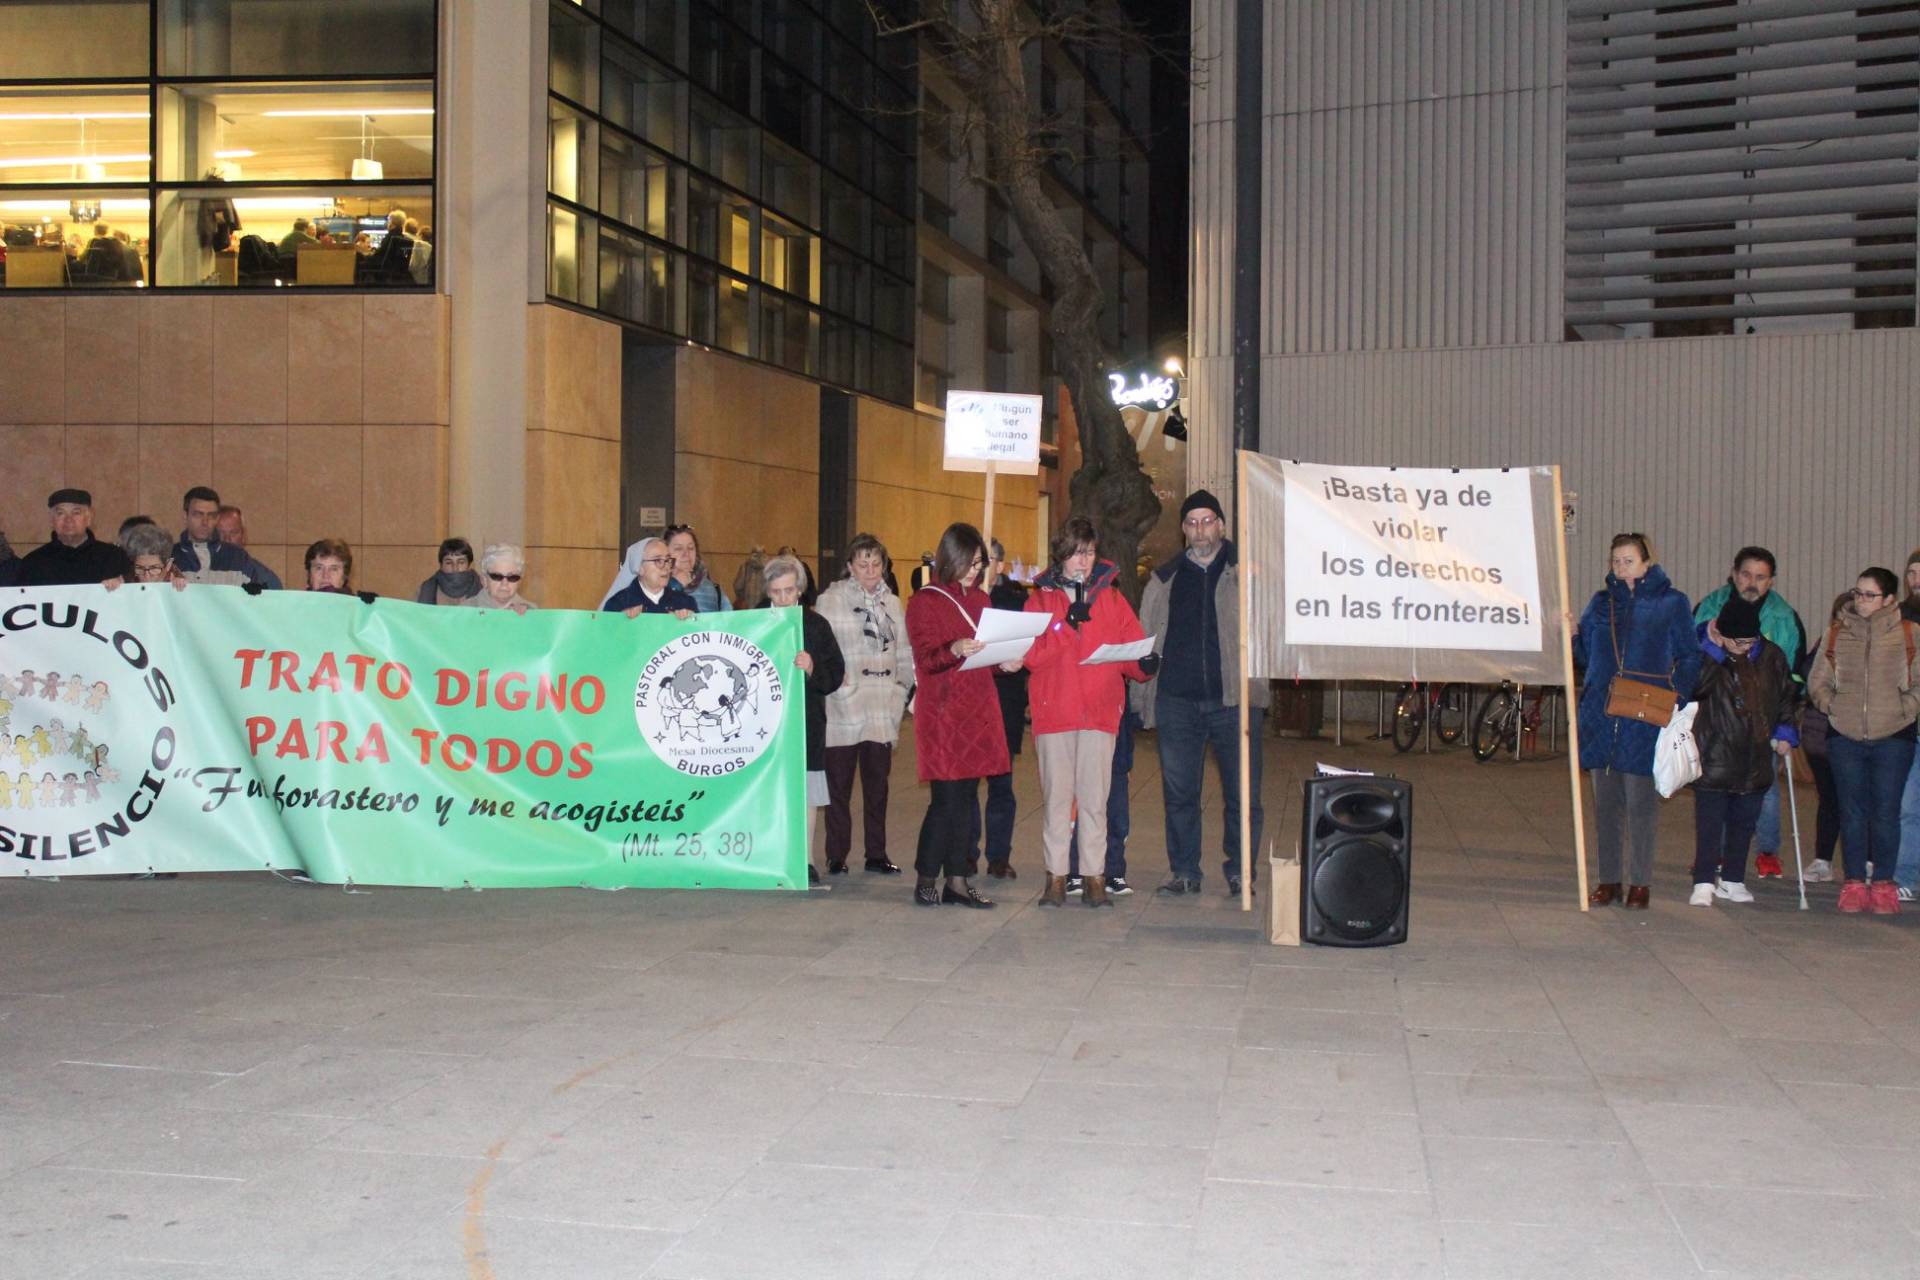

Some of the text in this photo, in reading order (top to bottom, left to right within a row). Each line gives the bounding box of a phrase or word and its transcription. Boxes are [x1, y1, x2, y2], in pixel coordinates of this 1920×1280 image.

[1323, 477, 1492, 510] ¡Basta ya de
[1373, 518, 1447, 543] violar
[1321, 552, 1502, 584] los derechos
[1296, 595, 1529, 625] en las fronteras!
[234, 649, 606, 715] TRATO DIGNO
[636, 633, 782, 708] PASTORAL CON INMIGRANTES
[245, 716, 593, 779] PARA TODOS
[669, 746, 754, 756] Mesa Diocesana
[677, 757, 746, 776] BURGOS
[435, 795, 454, 827] y
[469, 798, 515, 818] me
[622, 832, 753, 863] (Mt. 25, 38)
